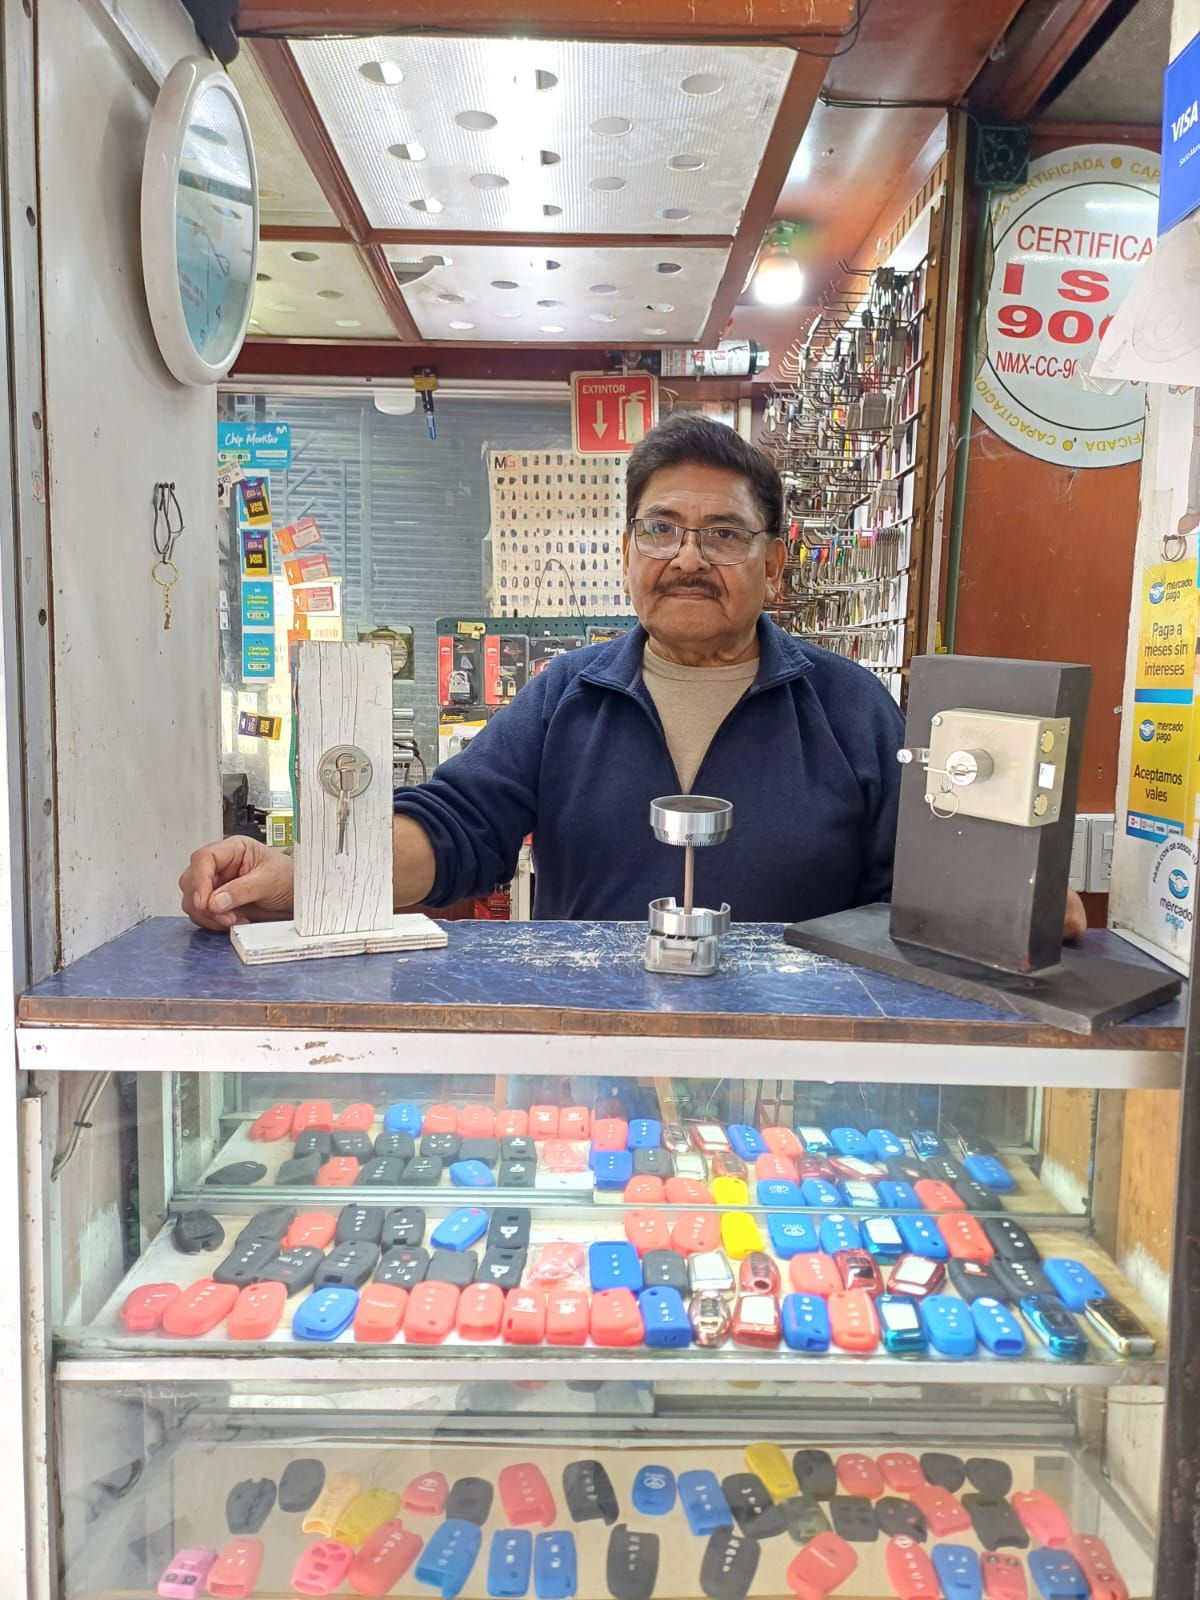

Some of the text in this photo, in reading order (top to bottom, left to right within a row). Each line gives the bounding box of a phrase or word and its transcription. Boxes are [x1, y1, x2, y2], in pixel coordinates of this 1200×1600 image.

[1170, 100, 1199, 143] VISA
[1008, 159, 1104, 204] CERTIFICADA
[582, 384, 626, 394] EXTINTOR
[225, 432, 244, 447] Chip
[1166, 578, 1193, 590] mercado
[1165, 590, 1181, 602] pago
[1152, 622, 1183, 640] Paga a
[1144, 640, 1188, 657] meses sin
[1144, 662, 1185, 676] intereses
[1156, 721, 1184, 732] mercado
[1155, 732, 1172, 744] pago
[1133, 764, 1183, 785] Aceptamos
[1145, 786, 1168, 802] vales
[1160, 898, 1192, 922] mercado
[1165, 912, 1184, 930] pago
